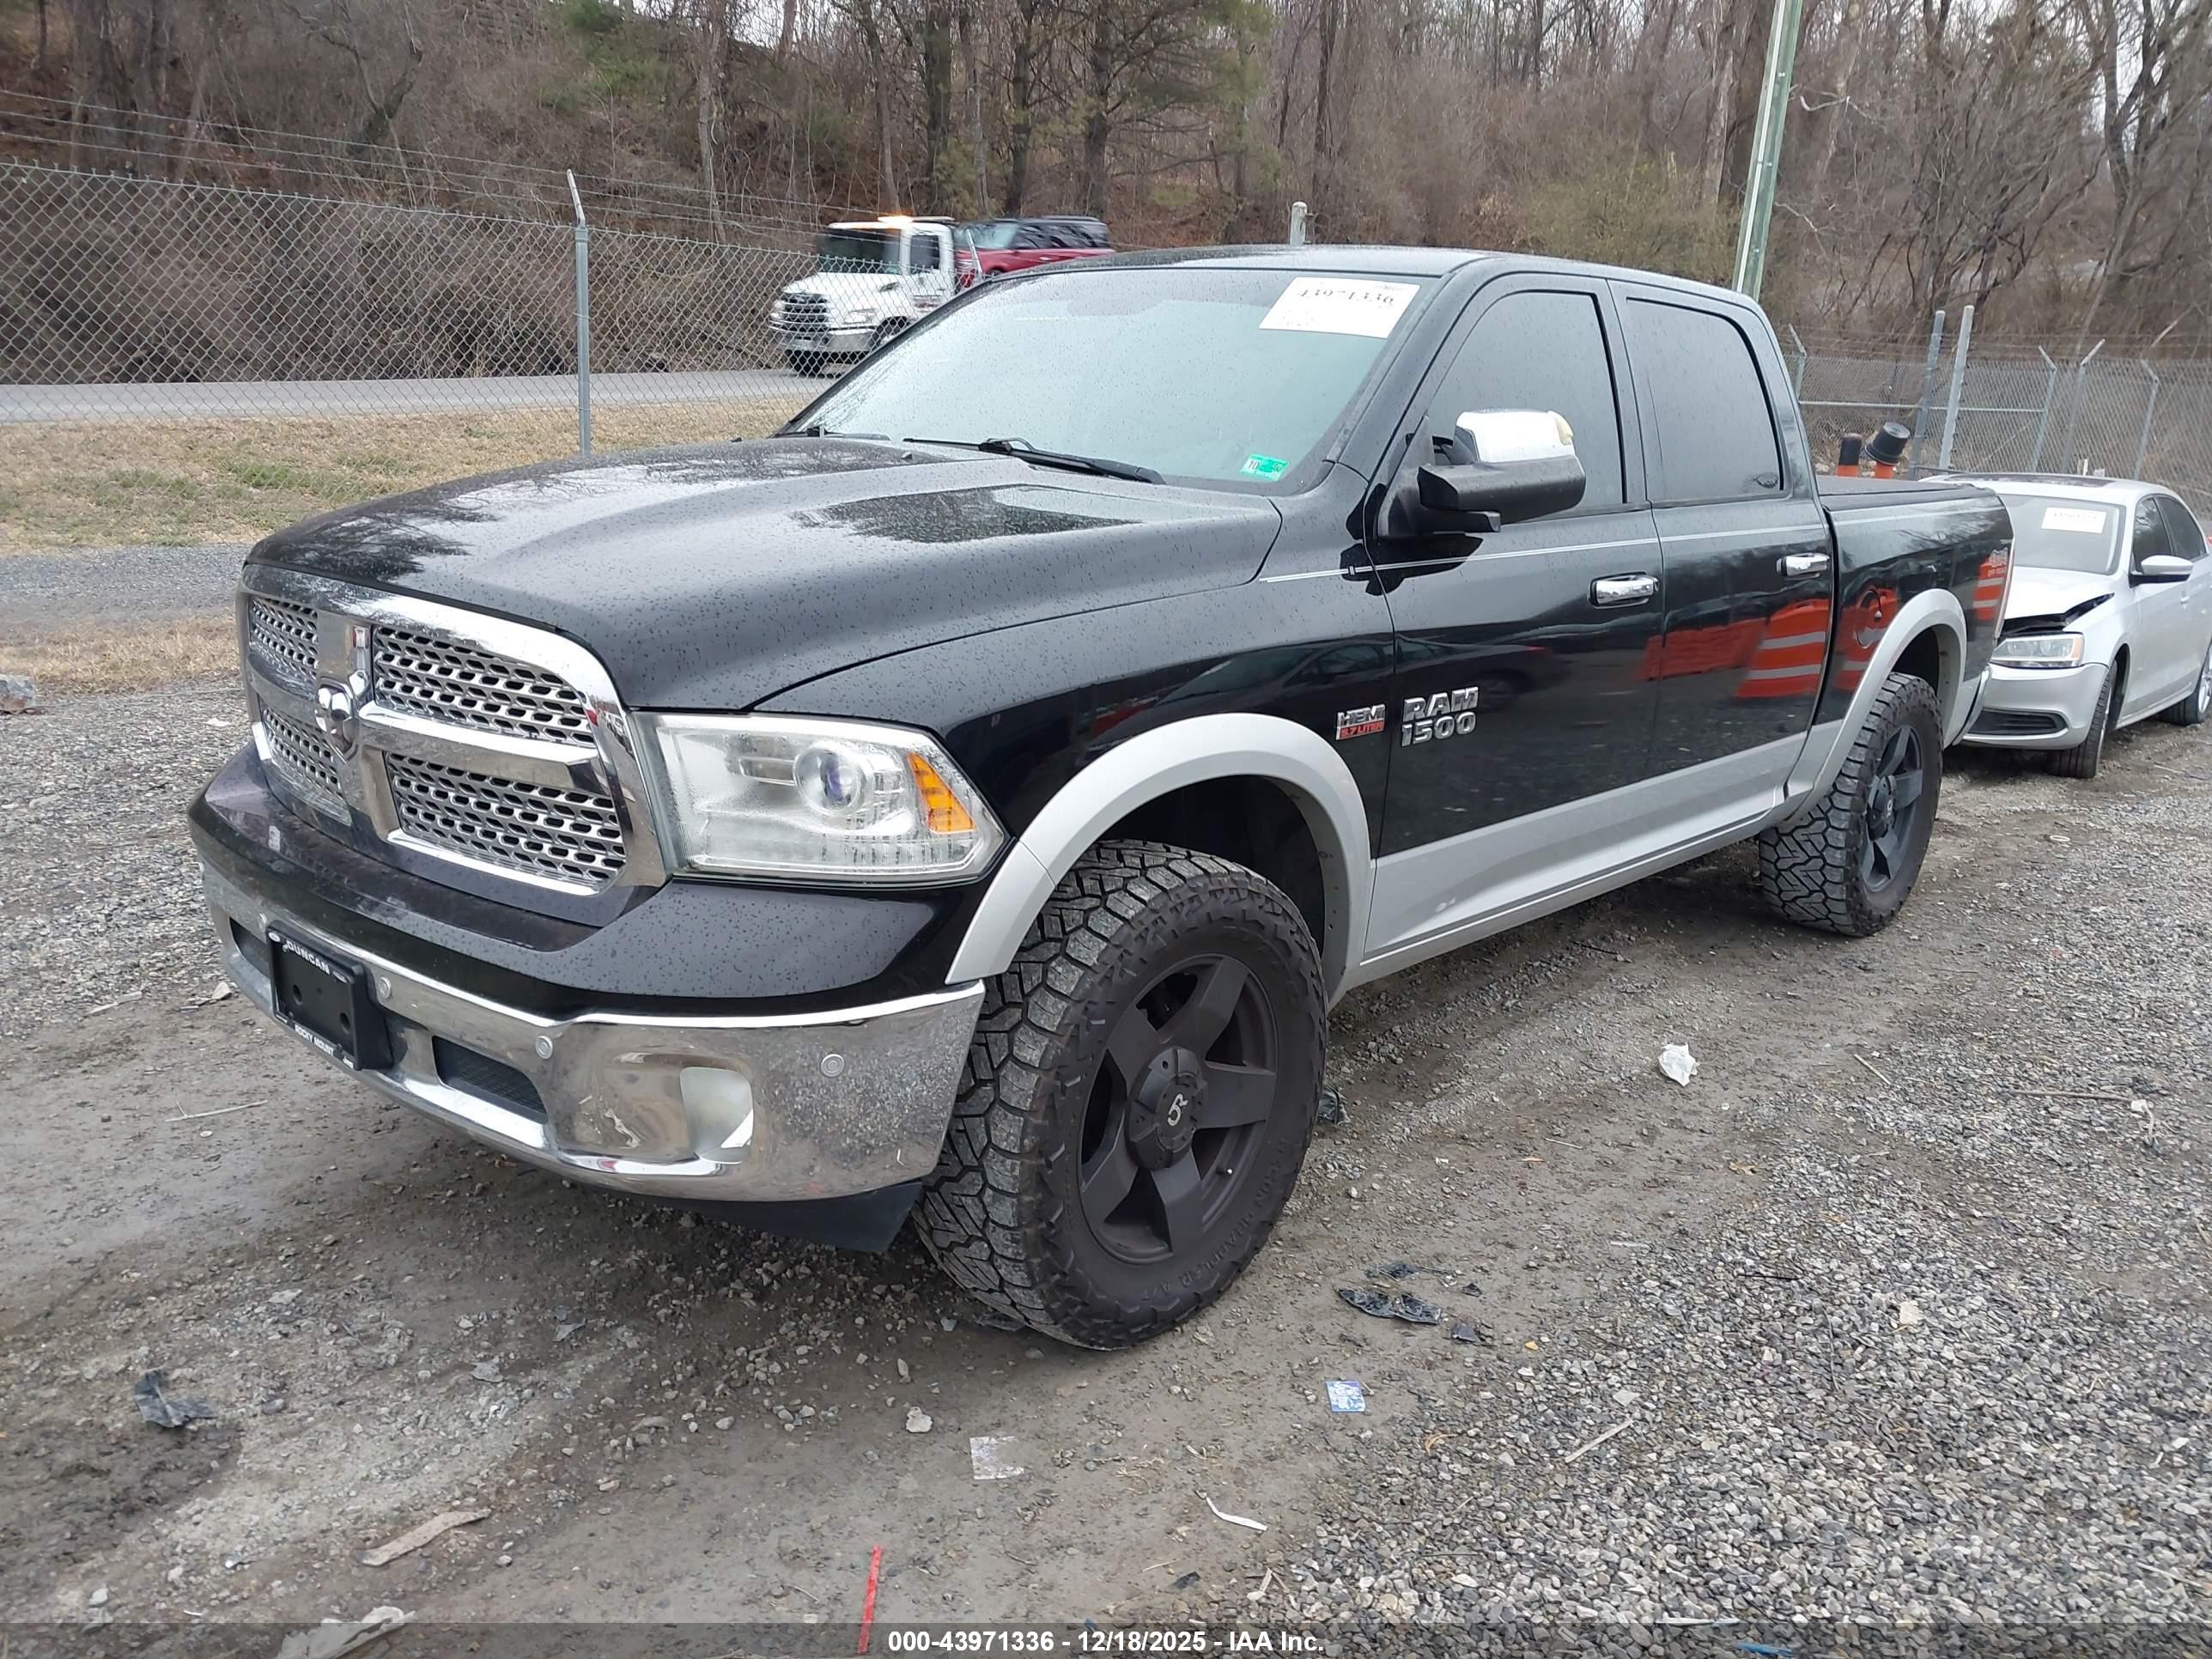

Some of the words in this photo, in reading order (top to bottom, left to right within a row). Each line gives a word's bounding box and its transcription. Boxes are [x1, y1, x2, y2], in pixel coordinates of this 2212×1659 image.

[1337, 704, 1385, 726] HEMI
[1403, 687, 1479, 722] RAM
[1401, 711, 1476, 747] 1500
[286, 940, 331, 975] DUNCAN
[313, 1036, 335, 1057] MOUNT
